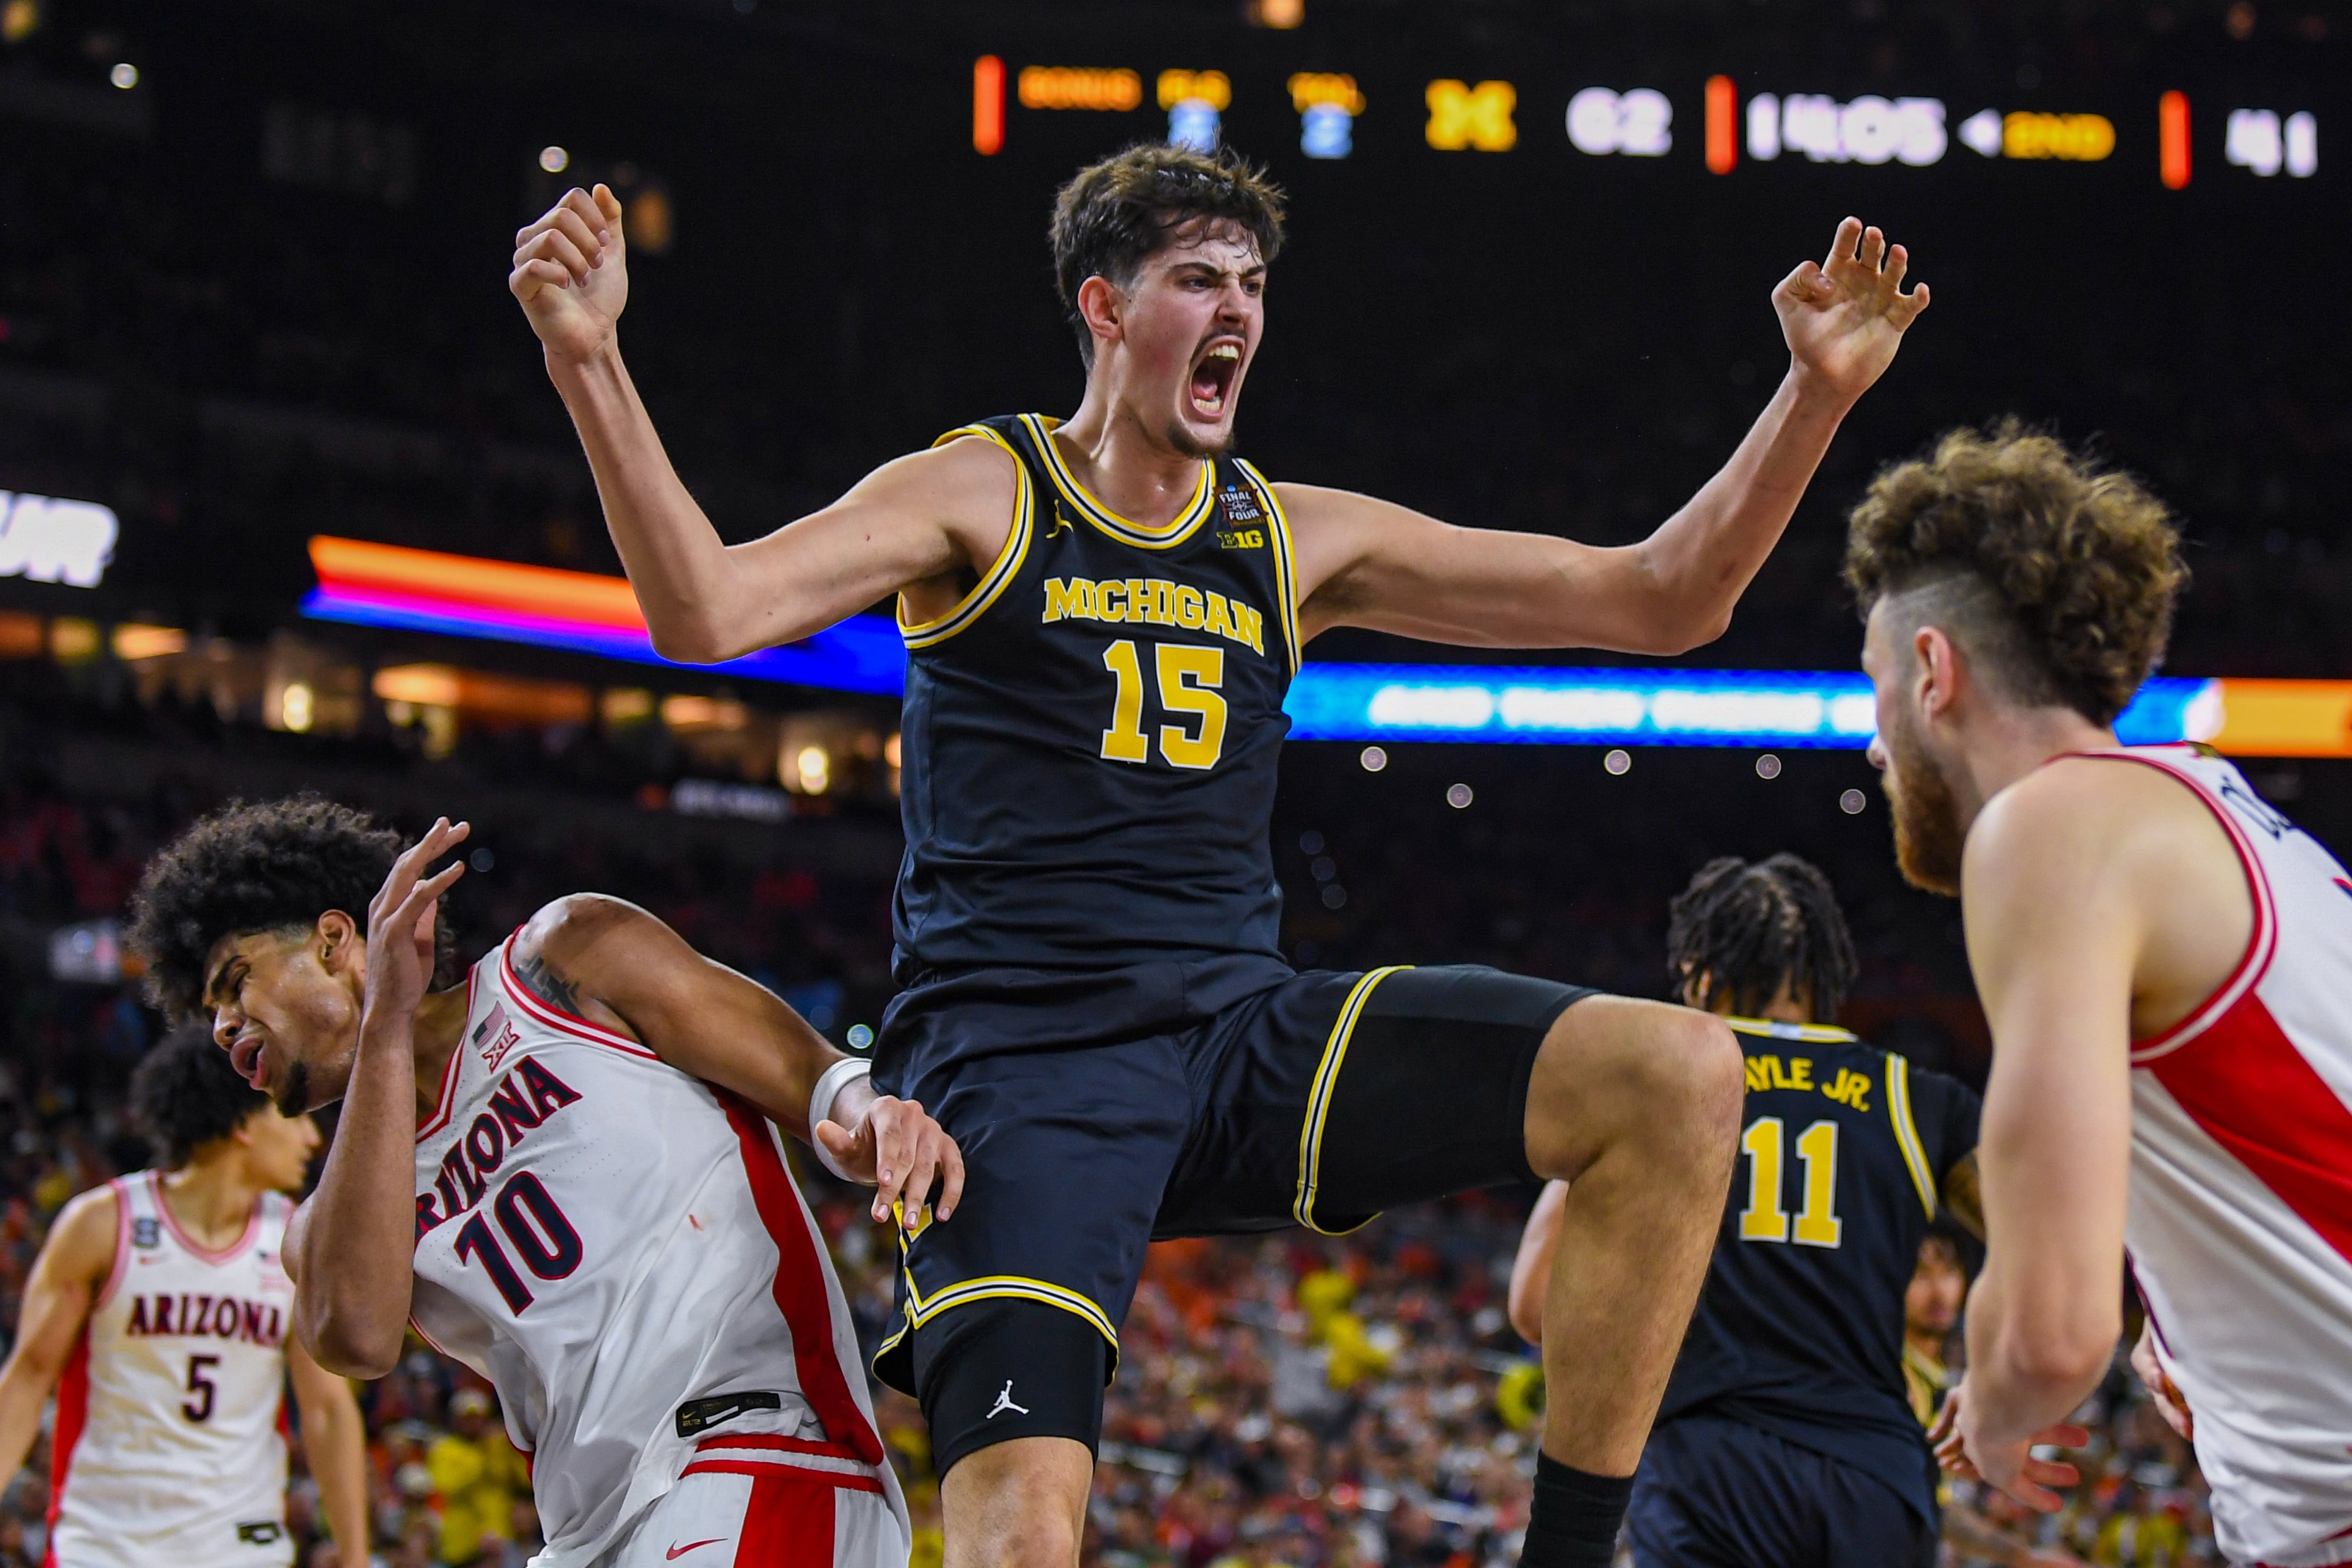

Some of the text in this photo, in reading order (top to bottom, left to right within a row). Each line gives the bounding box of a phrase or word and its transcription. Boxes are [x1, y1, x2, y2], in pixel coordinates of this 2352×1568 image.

[1565, 87, 1673, 156] 62
[2225, 109, 2318, 178] 41
[1219, 491, 1252, 503] FINAL
[1228, 508, 1260, 520] FOUR
[1042, 577, 1265, 657] MICHIGAN
[1100, 639, 1228, 770] 15
[1744, 1055, 1872, 1112] AYLE JR.
[416, 1055, 583, 1241] RIZONA
[1739, 1116, 1842, 1249] 11
[453, 1170, 583, 1318] 10
[181, 1354, 222, 1423] 5
